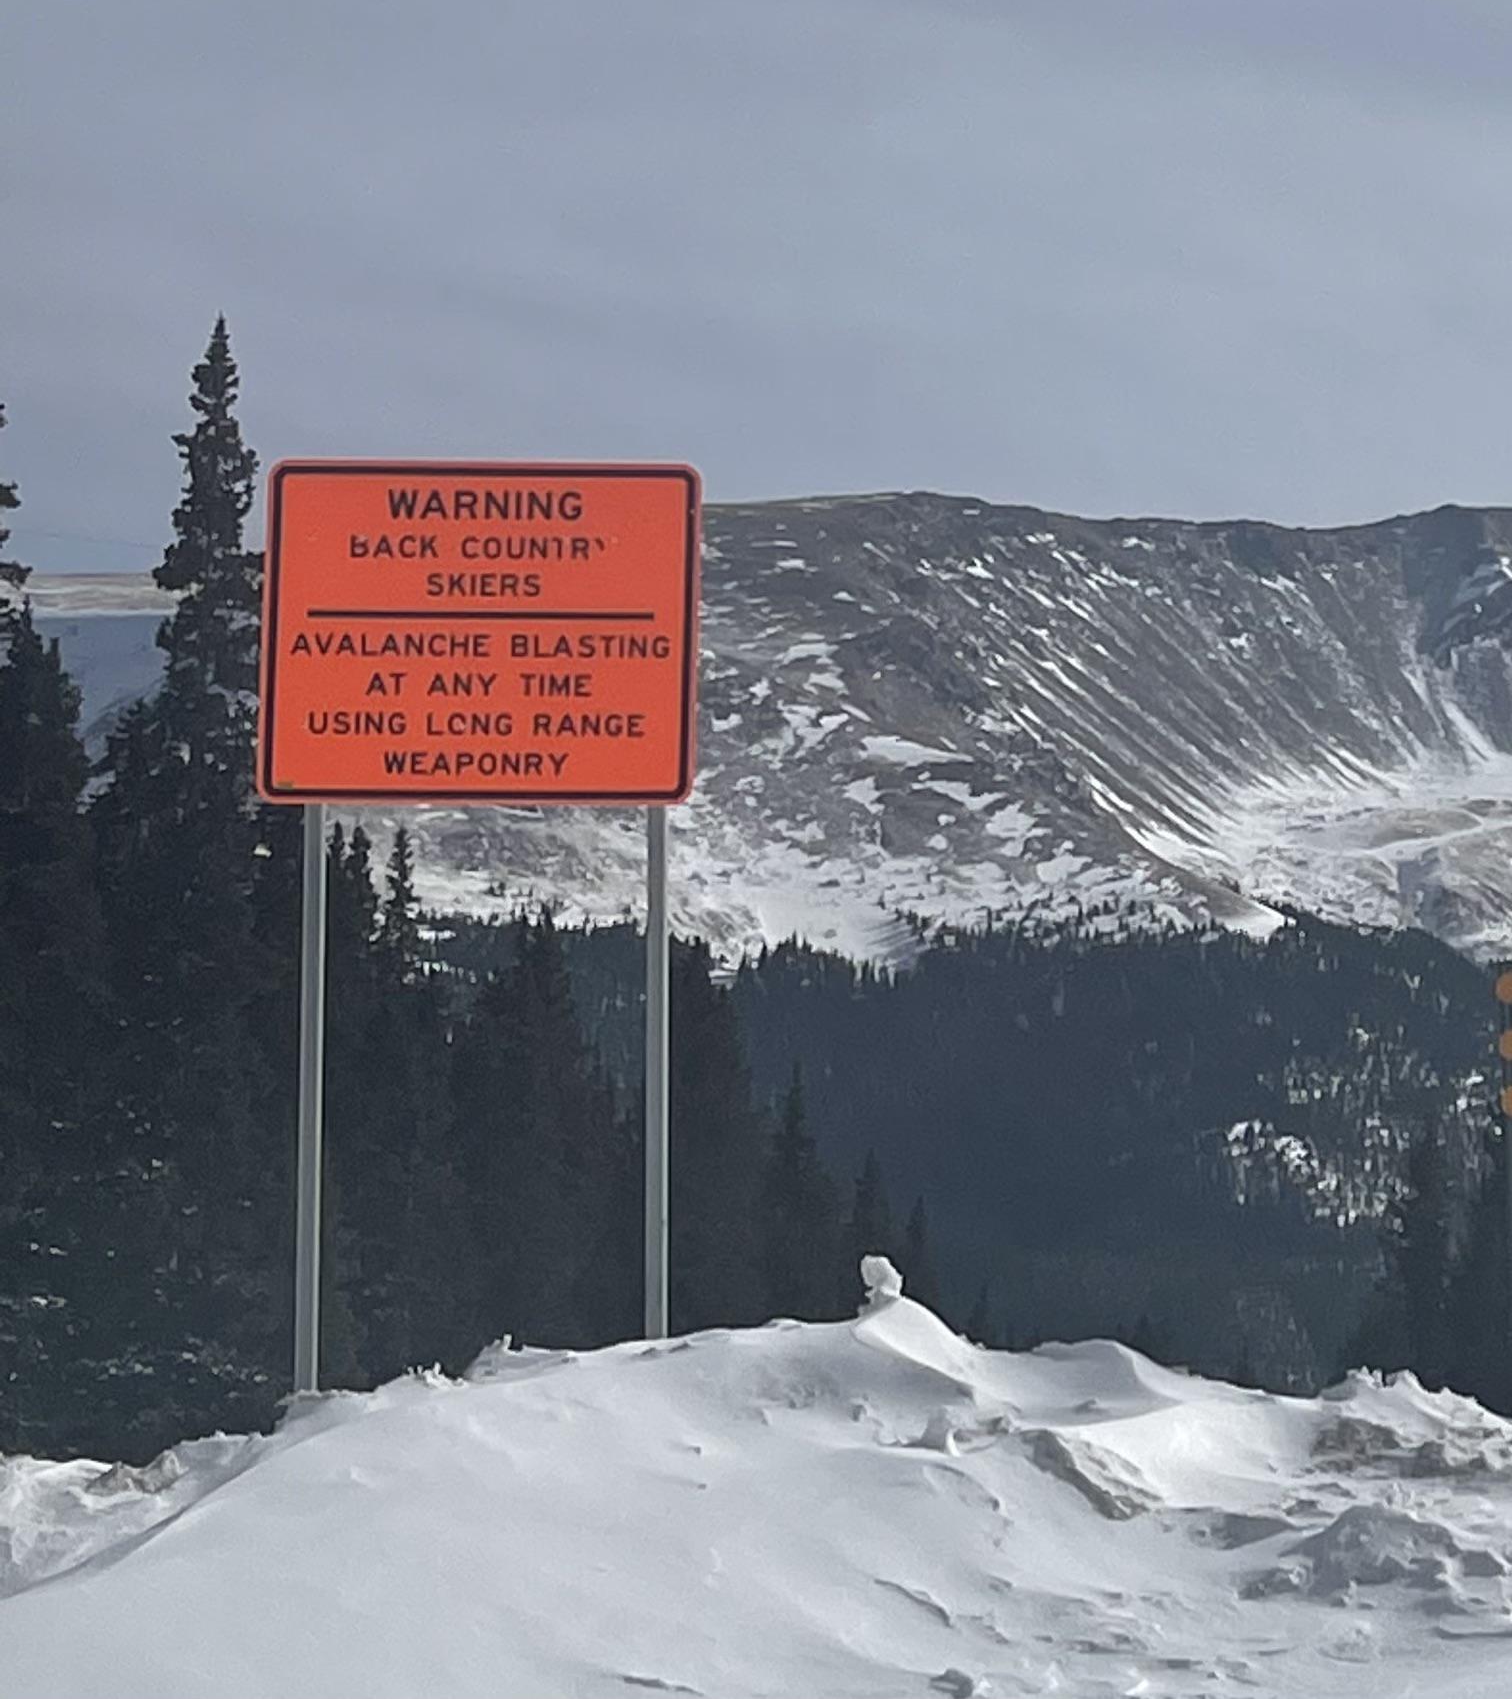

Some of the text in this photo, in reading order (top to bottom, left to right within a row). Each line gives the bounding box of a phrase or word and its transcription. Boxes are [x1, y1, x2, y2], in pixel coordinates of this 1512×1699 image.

[387, 488, 583, 522] WARNING
[349, 534, 440, 560] BACK
[426, 572, 542, 598] SKIERS
[290, 632, 671, 659] AVALANCHE BLASTING
[364, 672, 593, 698] AT ANY TIME
[308, 710, 646, 738] USING LONG RANGE
[383, 751, 569, 777] WEAPONRY
